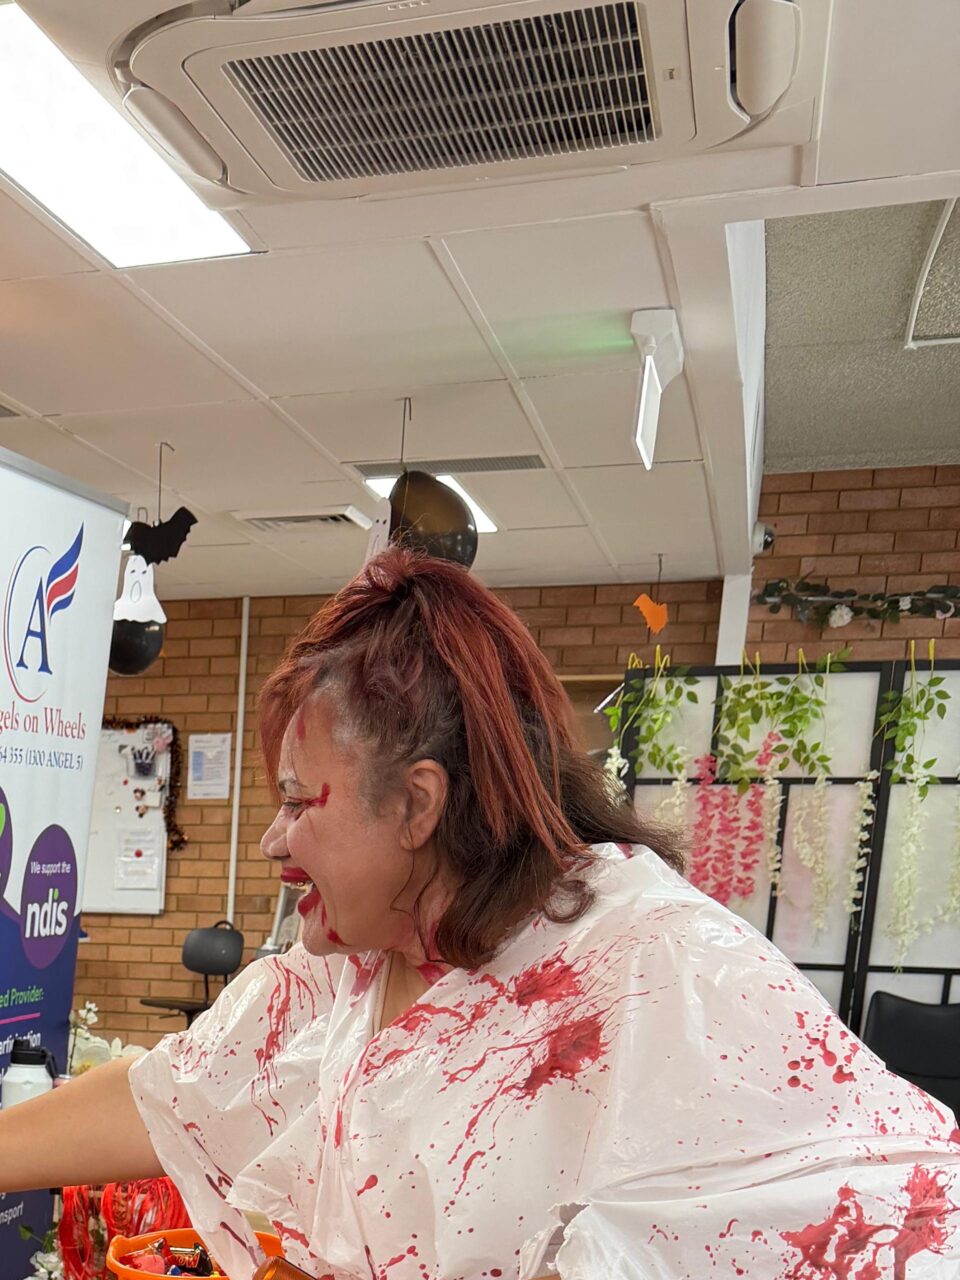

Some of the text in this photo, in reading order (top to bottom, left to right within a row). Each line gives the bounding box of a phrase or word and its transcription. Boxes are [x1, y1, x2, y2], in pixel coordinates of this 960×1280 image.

[23, 714, 39, 733] on
[44, 707, 87, 740] Wheels
[8, 746, 23, 764] 355
[46, 750, 74, 769] ANGEL
[30, 861, 71, 876] We support the
[25, 888, 68, 938] ndis
[10, 985, 44, 1003] Provider:
